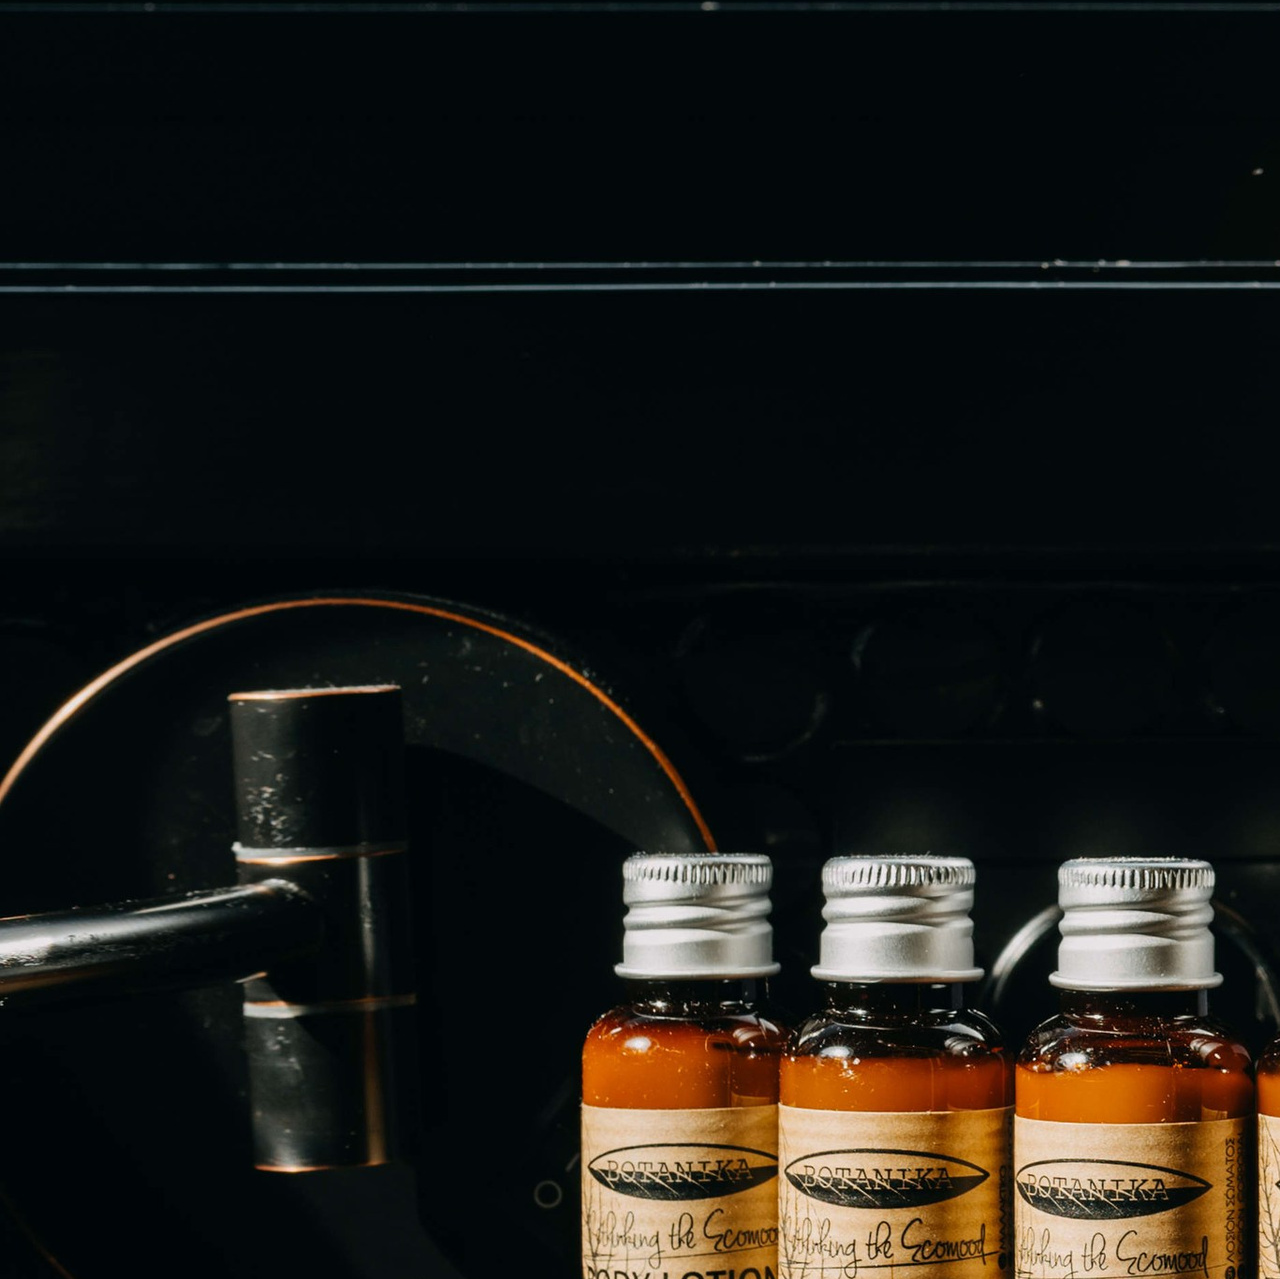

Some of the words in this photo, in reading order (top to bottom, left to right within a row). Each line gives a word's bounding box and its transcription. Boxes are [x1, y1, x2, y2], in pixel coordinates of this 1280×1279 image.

[606, 1158, 753, 1184] BOTANIKA
[803, 1165, 953, 1191] BOTANIKA
[1026, 1173, 1170, 1202] BOTANIKA
[669, 1212, 696, 1250] the
[866, 1221, 893, 1260] the
[1081, 1232, 1108, 1273] the
